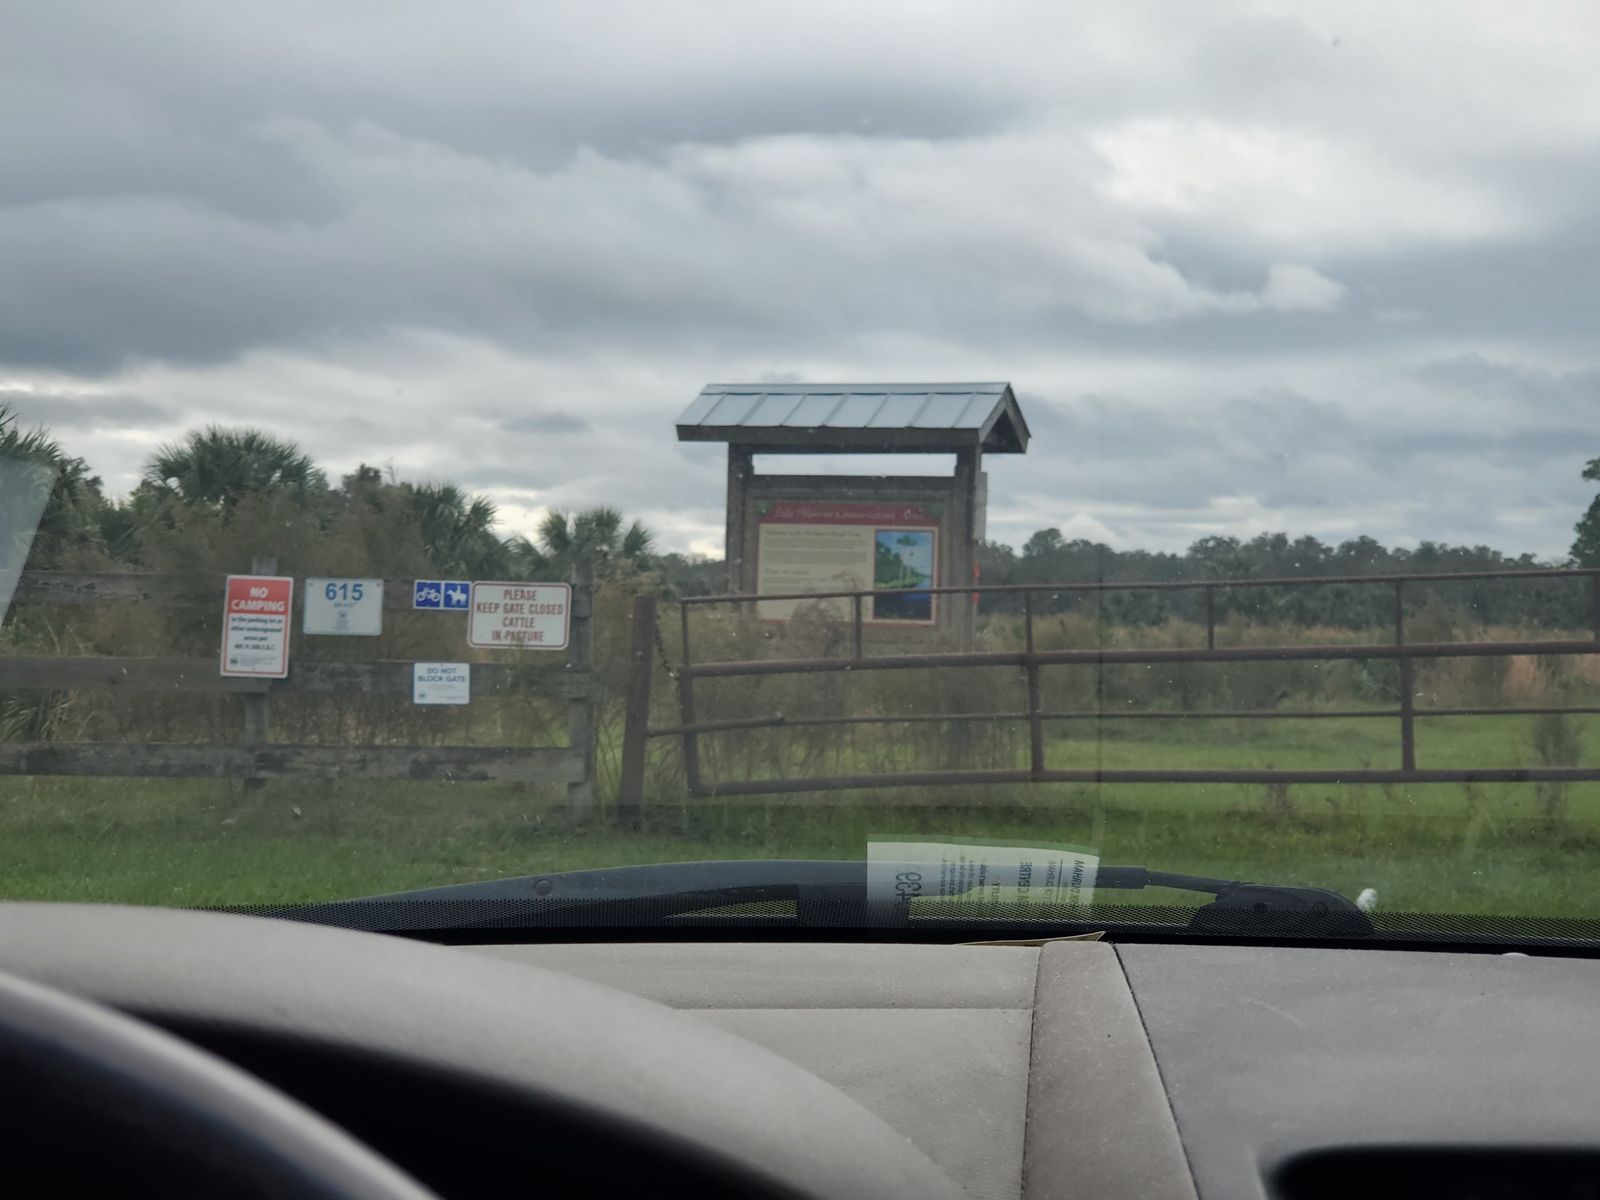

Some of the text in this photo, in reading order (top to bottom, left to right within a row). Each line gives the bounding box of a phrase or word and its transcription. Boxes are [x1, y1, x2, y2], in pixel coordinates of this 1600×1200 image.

[250, 586, 269, 598] NO
[325, 583, 364, 601] 615
[503, 589, 537, 601] PLEASE
[231, 599, 286, 613] CAMPING
[476, 602, 564, 615] KEEP GATE CLOSED
[503, 616, 535, 628] CATTLE
[491, 630, 545, 642] IN PASTURE
[426, 667, 457, 675] DO NOT
[417, 675, 466, 683] BLOCK GATE
